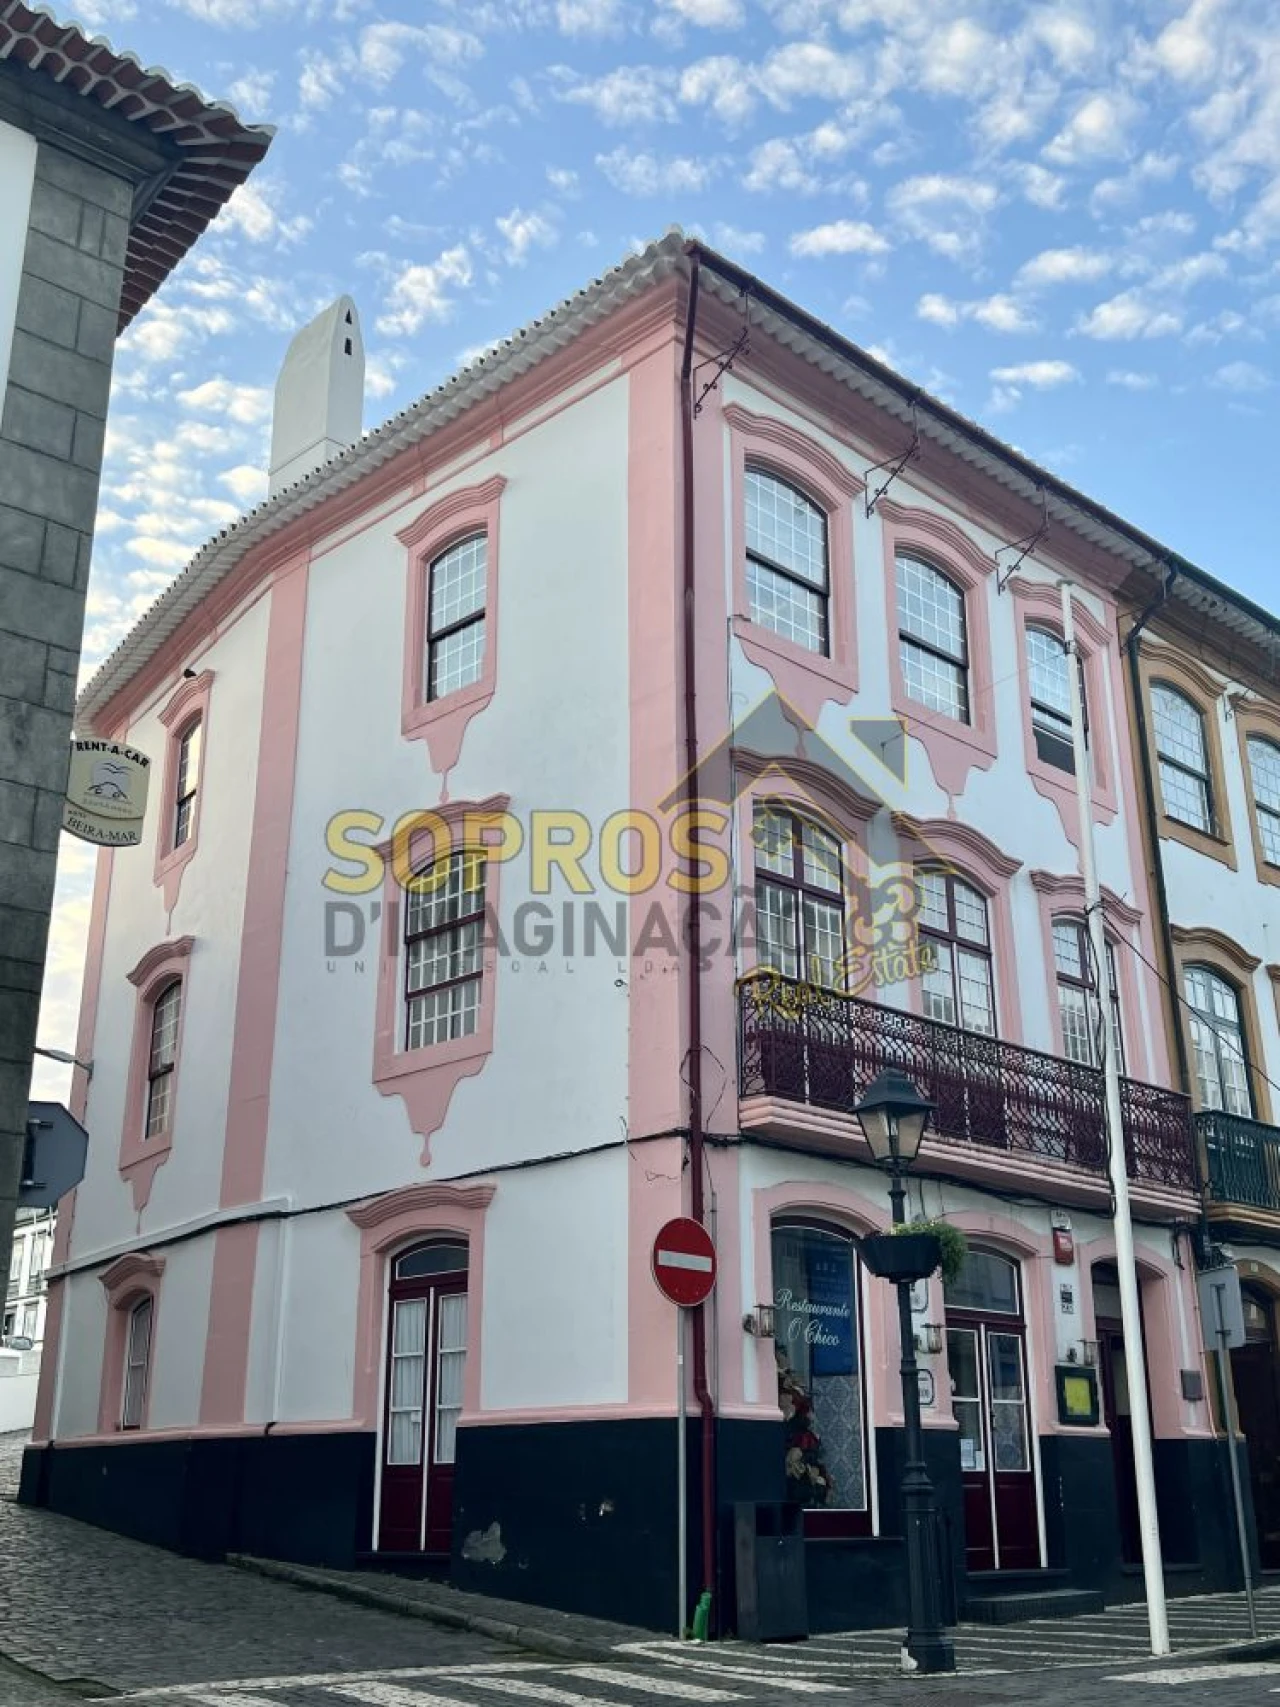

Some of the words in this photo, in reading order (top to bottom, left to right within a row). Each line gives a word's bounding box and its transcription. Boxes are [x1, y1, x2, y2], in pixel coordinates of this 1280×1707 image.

[76, 741, 150, 768] RENT-A-CAR
[775, 1288, 850, 1318] Restaurante
[787, 1317, 804, 1341] O
[804, 1319, 840, 1346] Chico
